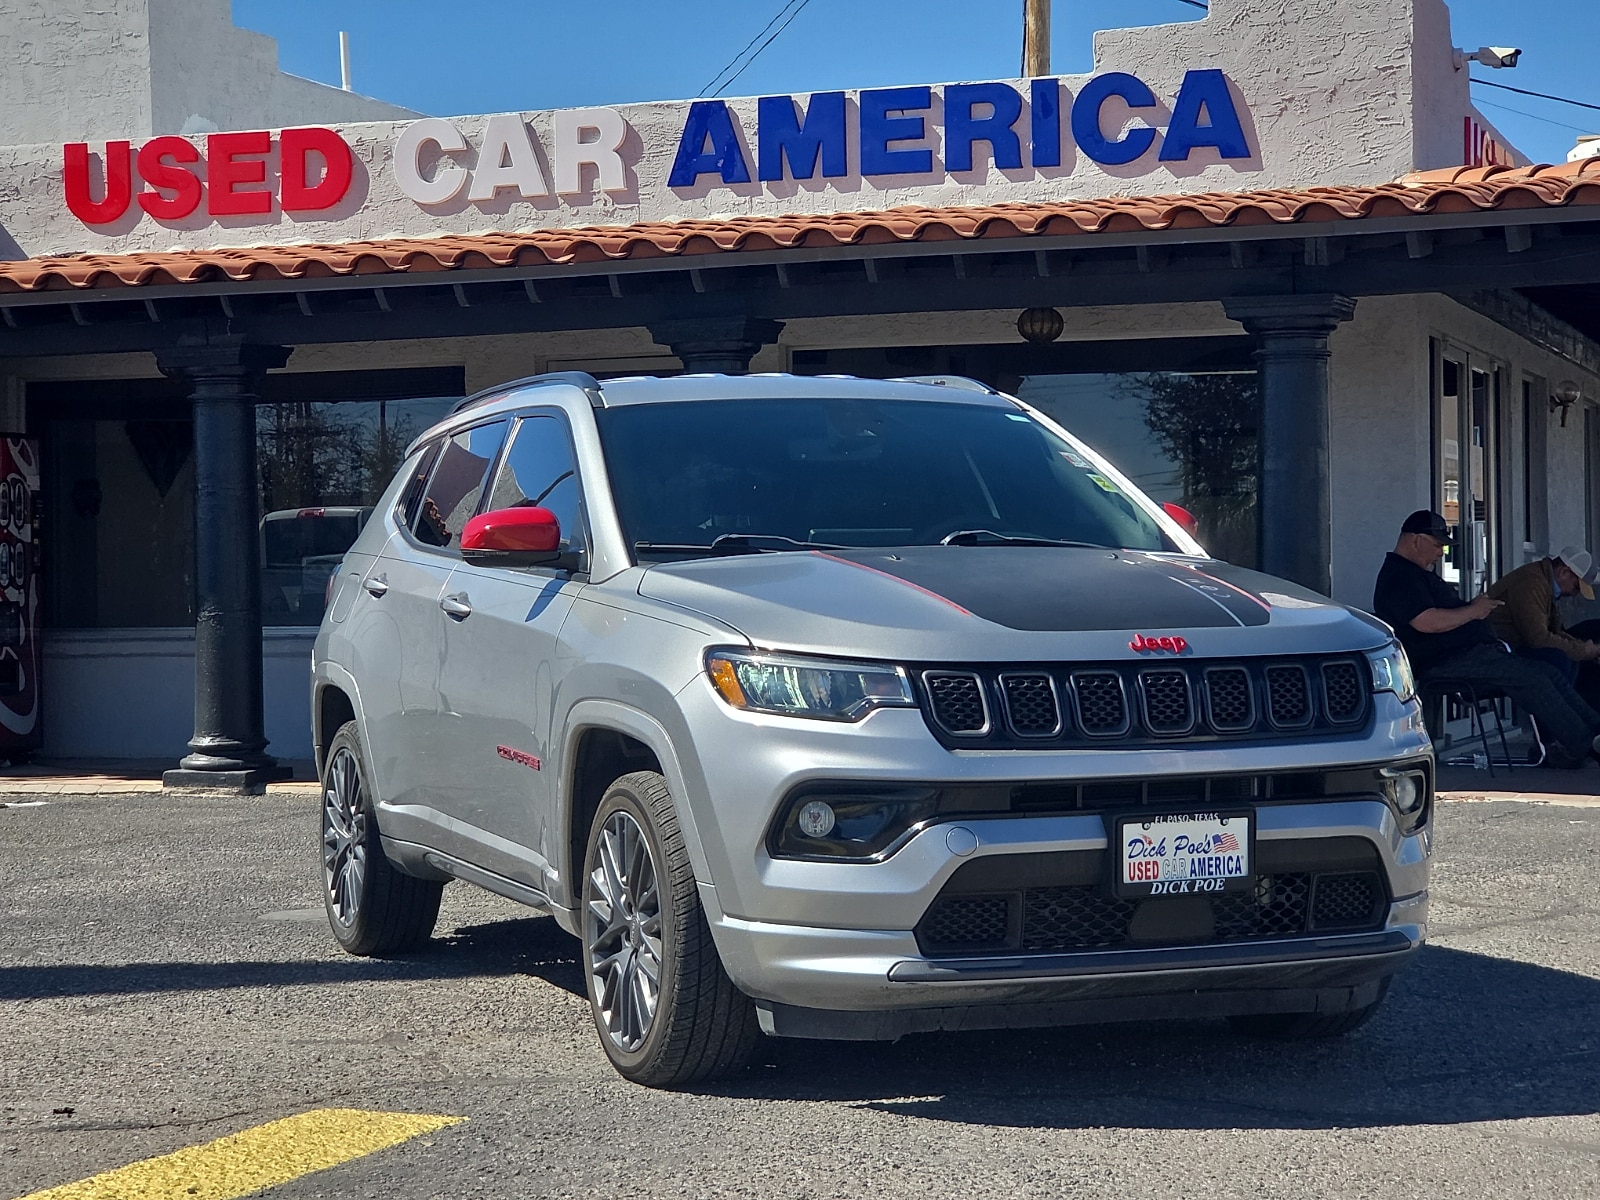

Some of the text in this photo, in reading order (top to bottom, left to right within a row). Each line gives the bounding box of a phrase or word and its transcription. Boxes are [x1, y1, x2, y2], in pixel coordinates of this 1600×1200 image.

[63, 69, 1251, 224] USED CAR AMERICA
[1128, 633, 1188, 654] Jeep
[1154, 815, 1166, 825] EL
[1194, 812, 1219, 822] TEXAS
[1127, 833, 1212, 859] Dick Poe's
[1128, 855, 1243, 882] USED CAR AMERICA
[1150, 878, 1226, 895] DICK POE
